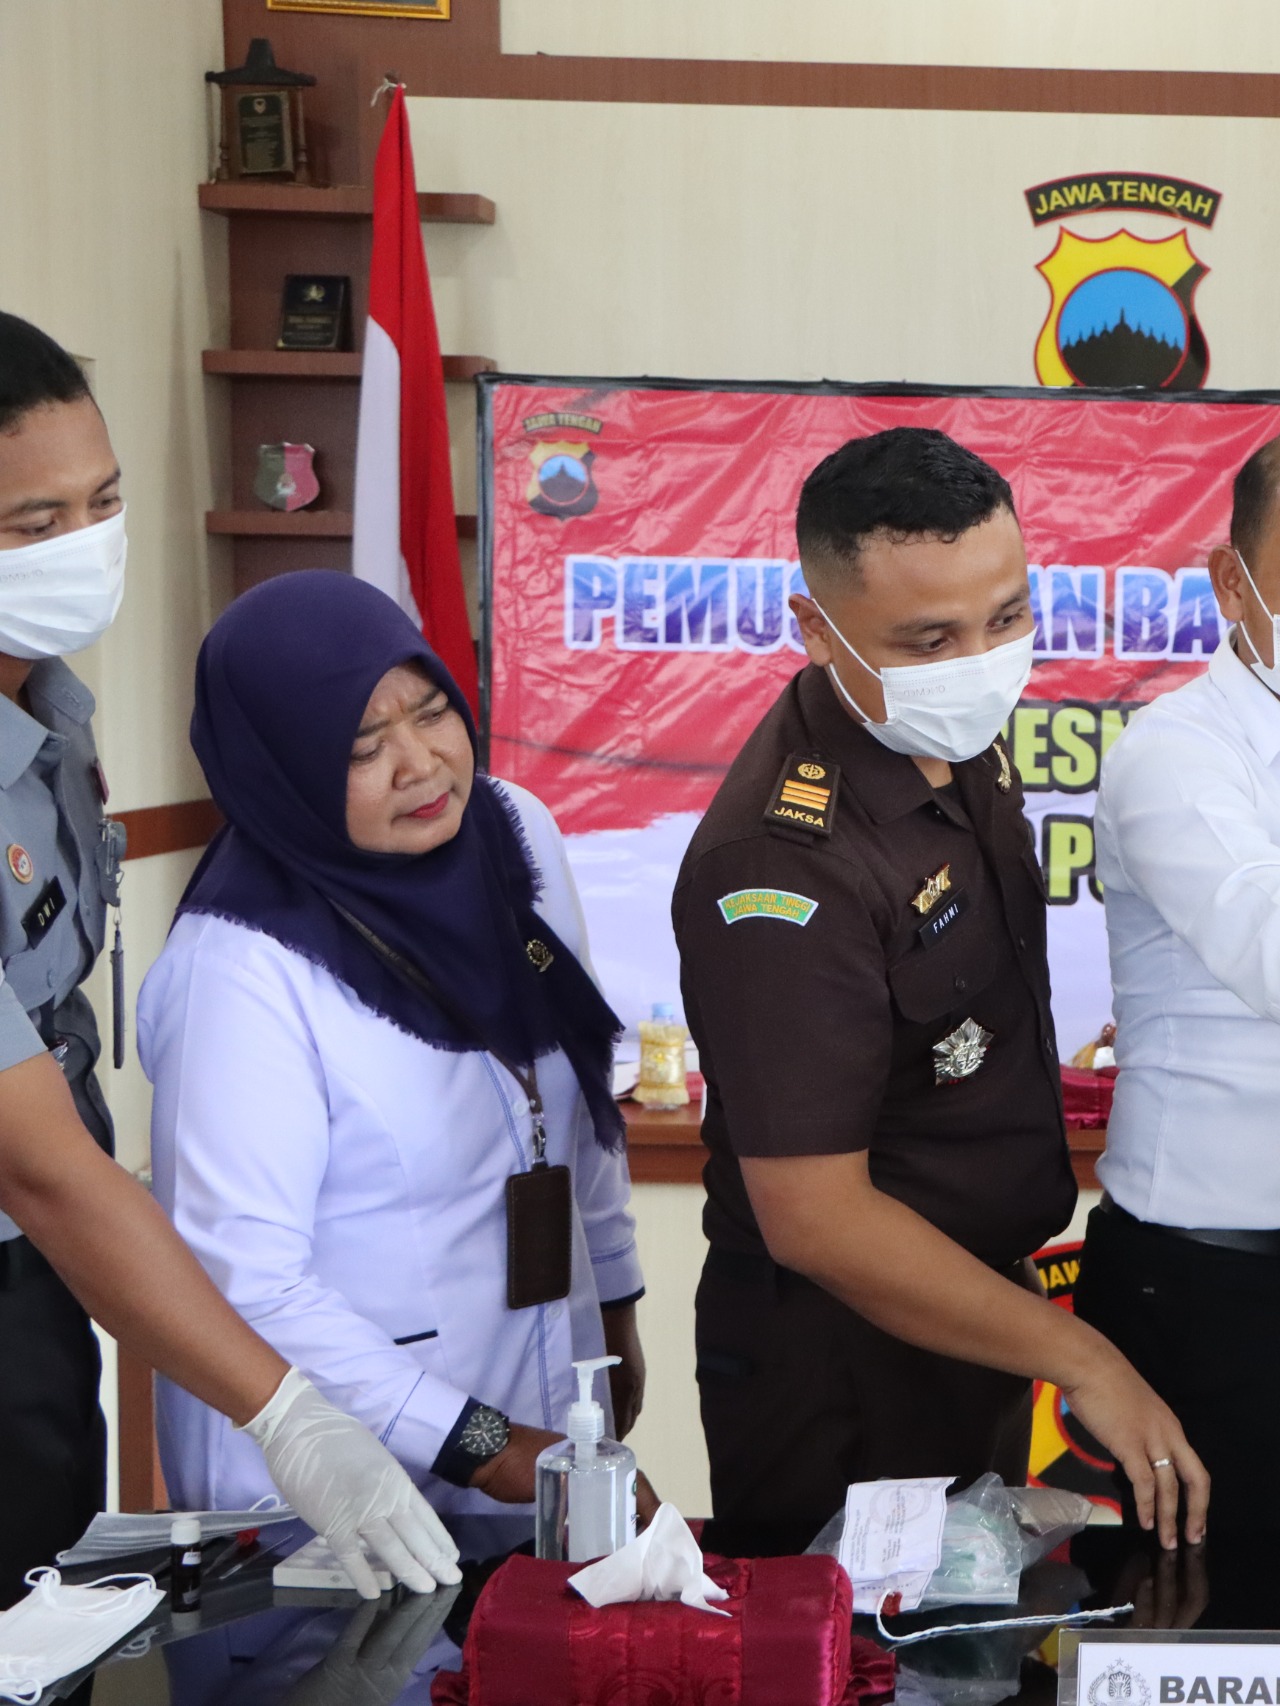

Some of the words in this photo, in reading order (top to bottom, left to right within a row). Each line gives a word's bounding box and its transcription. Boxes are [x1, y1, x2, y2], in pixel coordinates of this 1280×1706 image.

[1035, 182, 1105, 215] JAWA
[1106, 181, 1213, 217] TENGAH
[774, 806, 825, 828] JAKSA
[37, 898, 56, 927] DWI
[724, 893, 777, 910] KEJAKSAAN
[781, 895, 812, 913] TINGGI
[733, 903, 758, 917] JAWA
[761, 903, 800, 918] TENGAH
[933, 903, 959, 934] FAHMI
